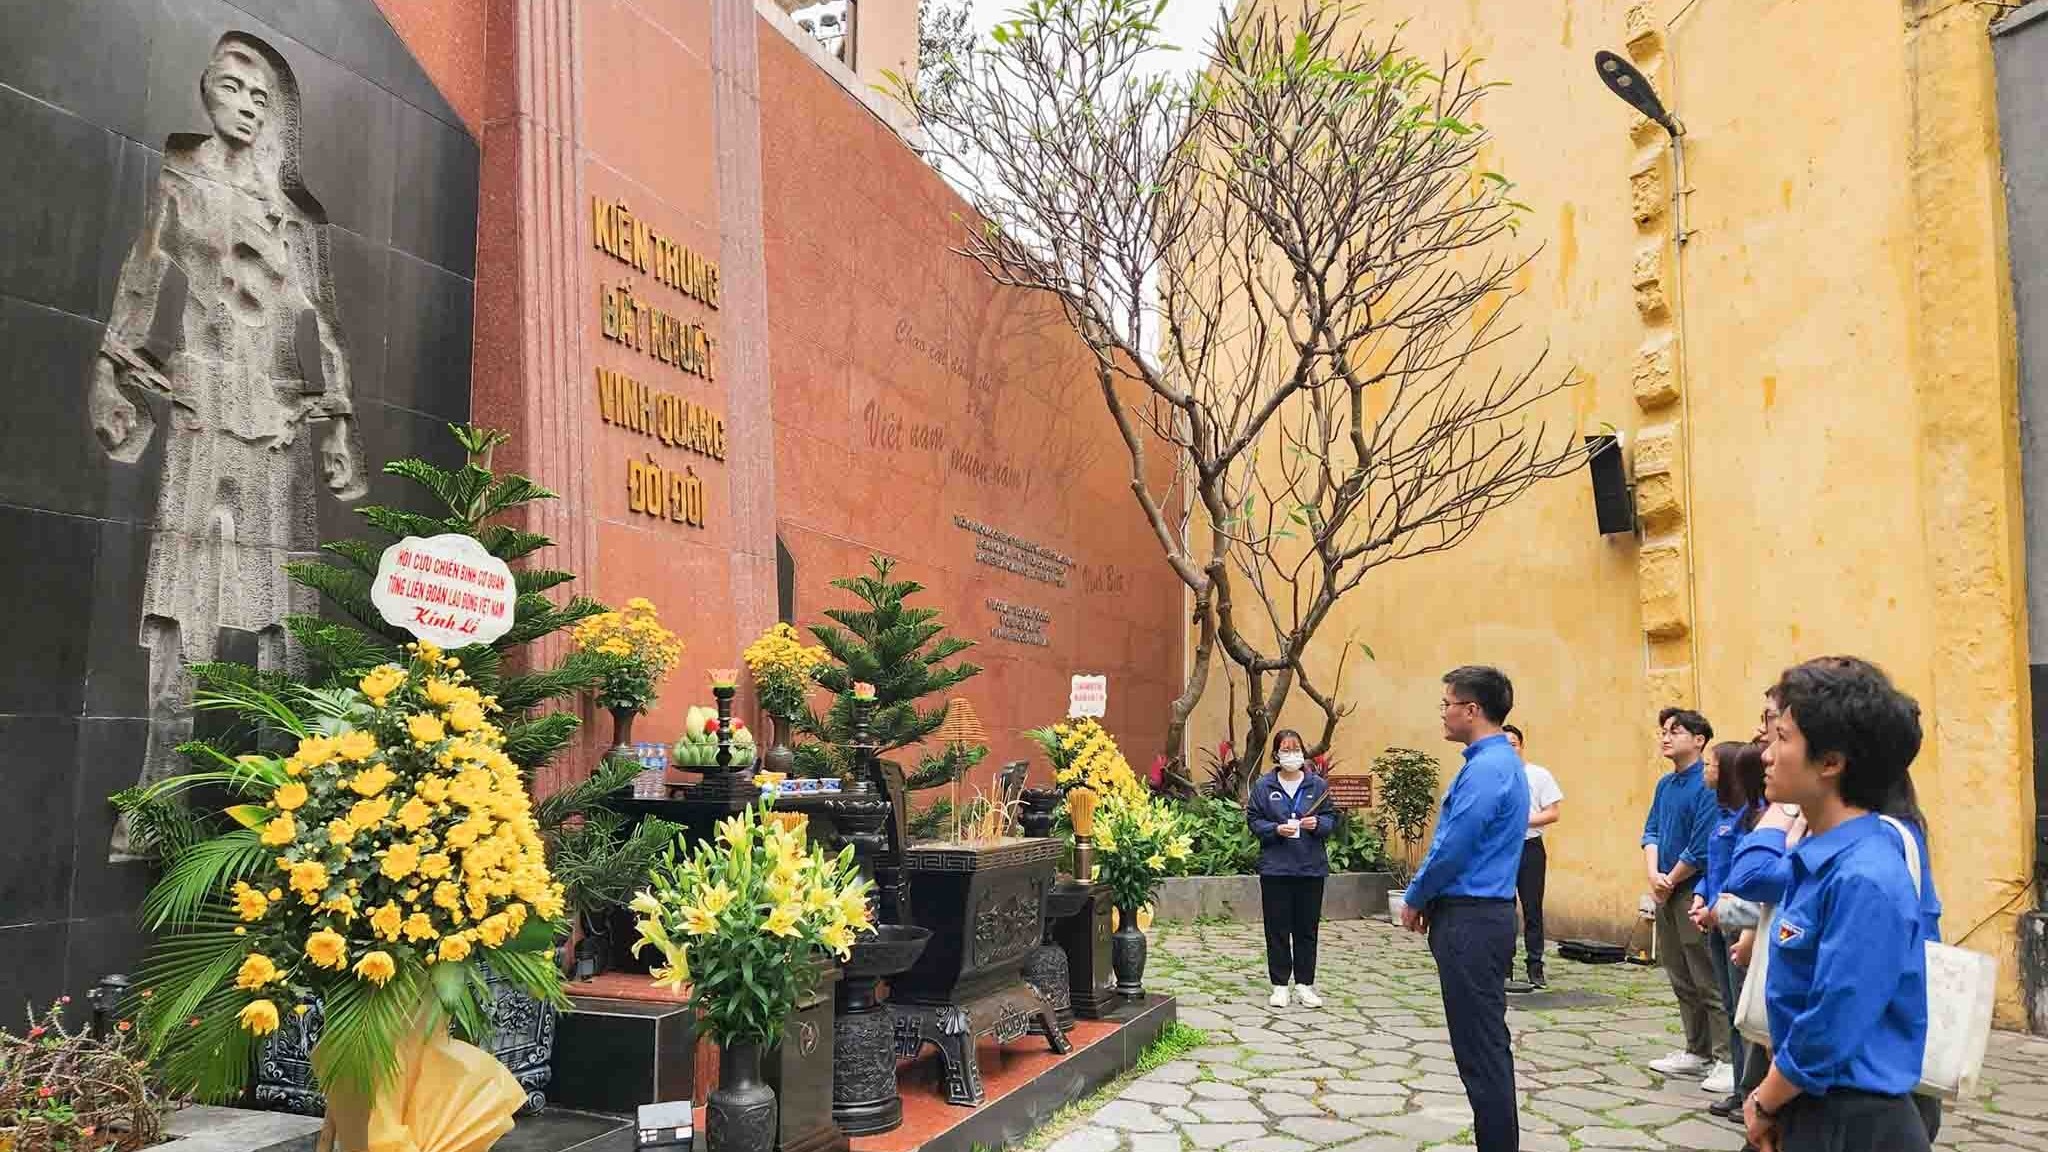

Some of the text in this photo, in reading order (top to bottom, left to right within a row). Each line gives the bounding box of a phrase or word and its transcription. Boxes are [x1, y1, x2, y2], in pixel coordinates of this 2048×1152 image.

[592, 196, 721, 310] KIÊN TRUNG
[601, 277, 715, 383] BẤT KHUẤT
[595, 366, 729, 461] VINH QUANG
